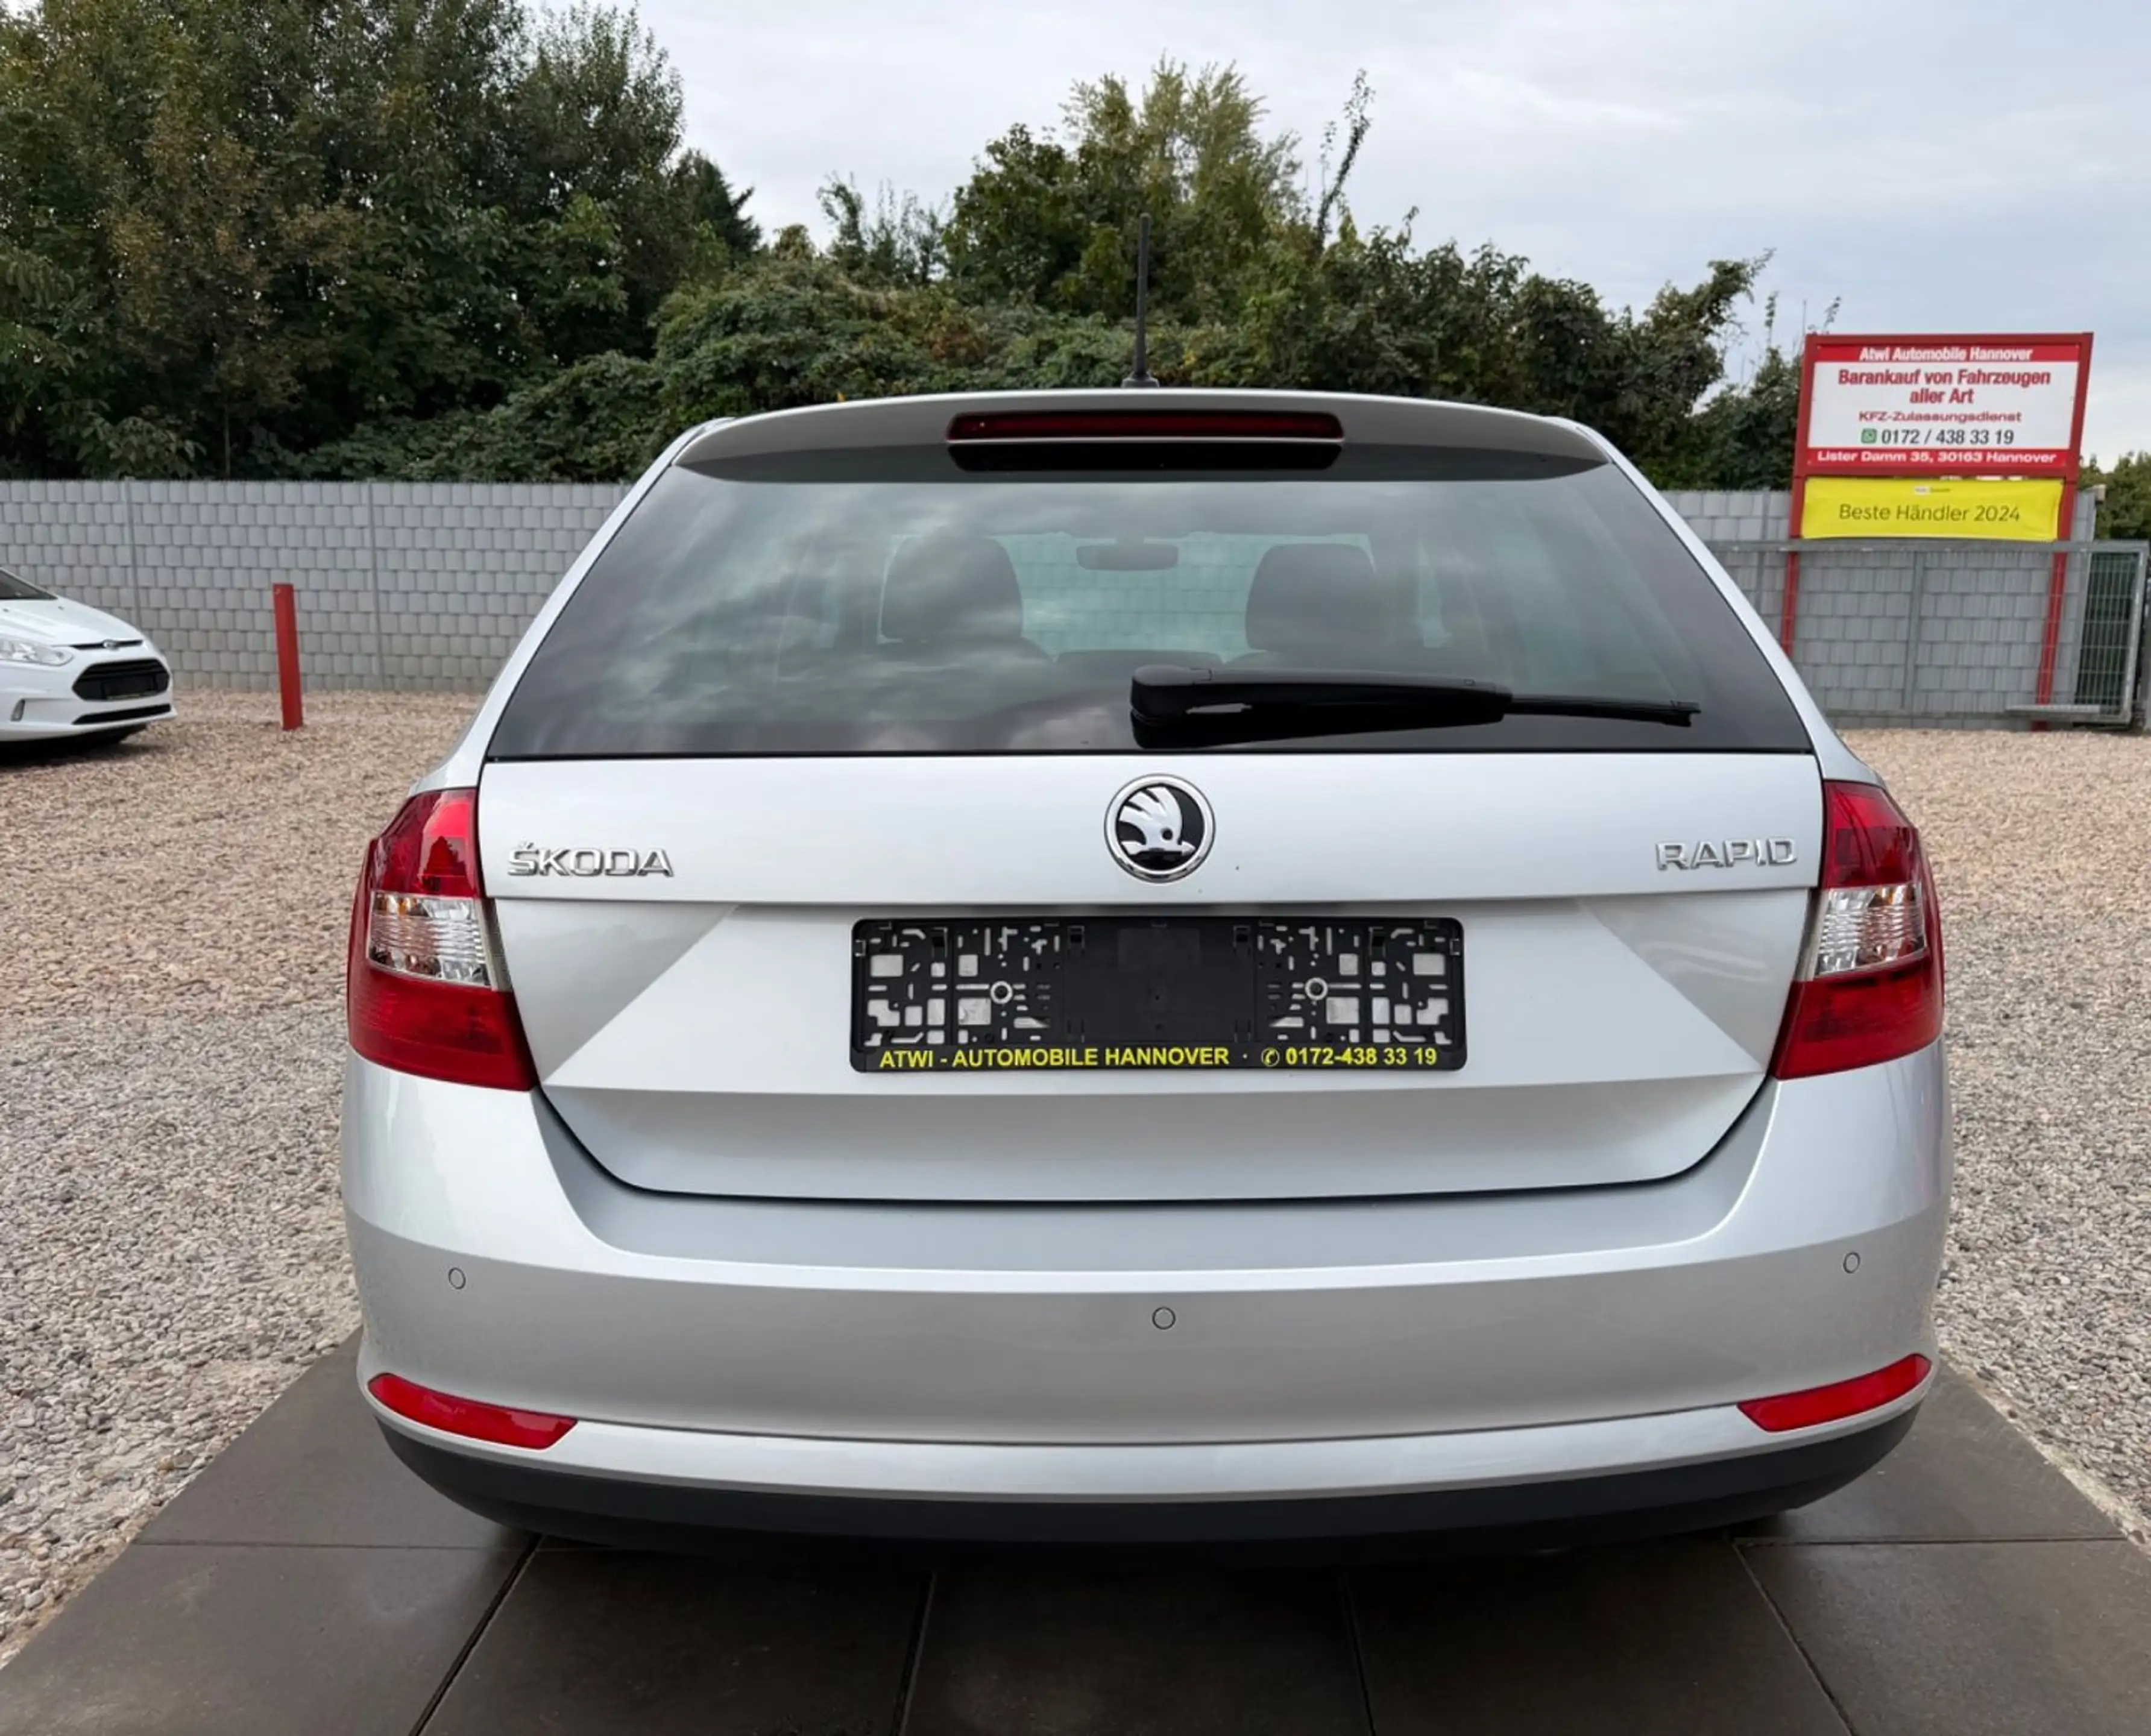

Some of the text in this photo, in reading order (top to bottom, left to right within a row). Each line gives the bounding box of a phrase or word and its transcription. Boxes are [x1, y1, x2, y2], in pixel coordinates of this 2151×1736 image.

[1892, 346, 1967, 360] Automobile
[1969, 346, 2034, 360] Hannover
[1838, 368, 2051, 388] Barankauf von Fahrzeugen
[1909, 388, 1974, 404] aller Art
[1858, 411, 2022, 423] KFZ-Zulassungsdienst
[1881, 429, 1921, 445] 0172
[1935, 429, 1965, 445] 438
[1969, 429, 1990, 445] 33
[1994, 429, 2015, 445] 19
[1817, 451, 2058, 464] Lister Damm 35, 30163 Hannover
[1839, 503, 2020, 522] Beste Händler 2024
[508, 841, 675, 877] ŠKODA
[1655, 835, 1798, 871] RAPID
[879, 1049, 933, 1068] ATWI
[952, 1048, 1099, 1068] AUTOMOBILE
[1104, 1047, 1230, 1066] HANNOVER
[1285, 1047, 1378, 1065] 0172-438
[1383, 1047, 1408, 1065] 33
[1414, 1047, 1437, 1065] 19
